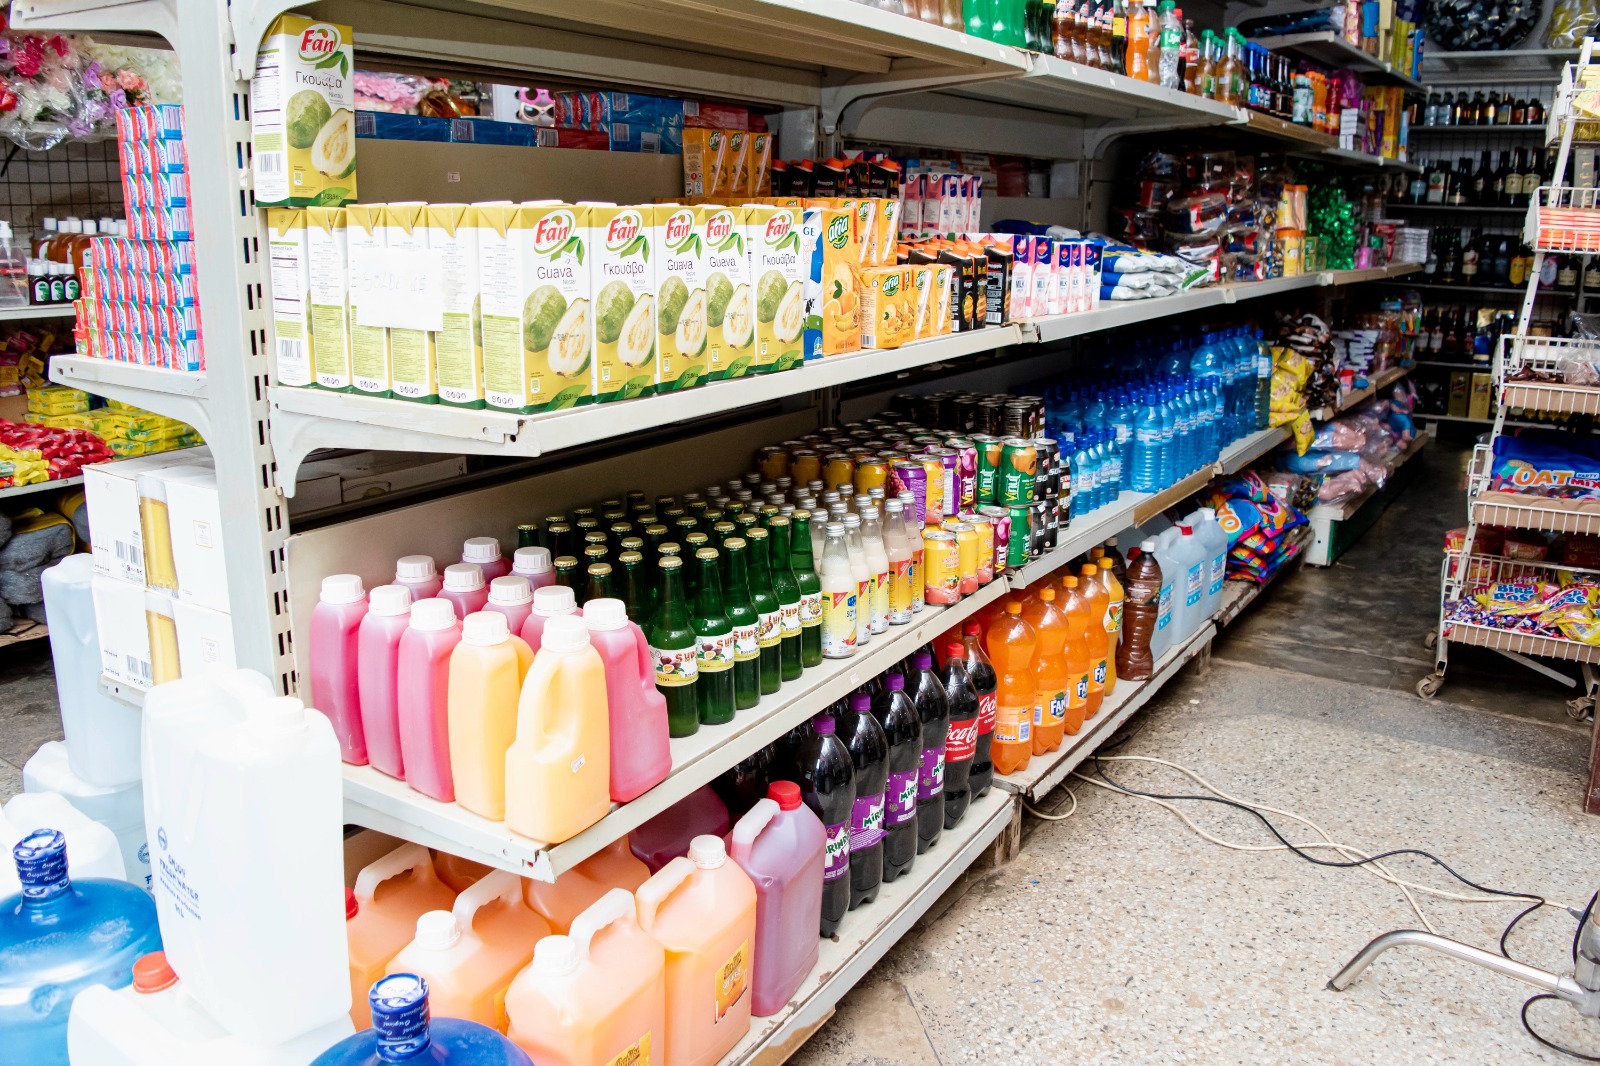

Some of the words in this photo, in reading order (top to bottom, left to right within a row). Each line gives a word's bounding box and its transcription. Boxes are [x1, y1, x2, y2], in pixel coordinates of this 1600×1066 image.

[301, 29, 334, 53] Fan
[535, 218, 568, 244] Fan
[607, 218, 636, 242] Fan
[666, 217, 690, 240] Fan
[706, 217, 730, 239] Fan
[765, 217, 789, 238] Fan
[803, 226, 816, 236] GE
[828, 214, 849, 243] afia
[603, 261, 645, 278] Γκουάβα
[667, 259, 694, 271] Guava
[709, 256, 737, 268] Guava
[762, 253, 796, 268] Γκουάβα
[537, 266, 573, 280] Guava
[882, 274, 899, 292] afia
[979, 468, 996, 497] Vinut
[1035, 474, 1048, 483] SO
[1514, 466, 1573, 486] OAT
[961, 475, 975, 505] Vinut
[1005, 473, 1021, 501] Vinut
[1047, 521, 1058, 530] SO
[1214, 501, 1241, 533] OA
[1035, 529, 1046, 537] SO
[994, 544, 1008, 573] Vinut
[1094, 667, 1106, 683] FA
[1076, 681, 1089, 698] FA
[26, 869, 51, 878] Original
[177, 878, 200, 902] WATER
[383, 1019, 411, 1028] Original
